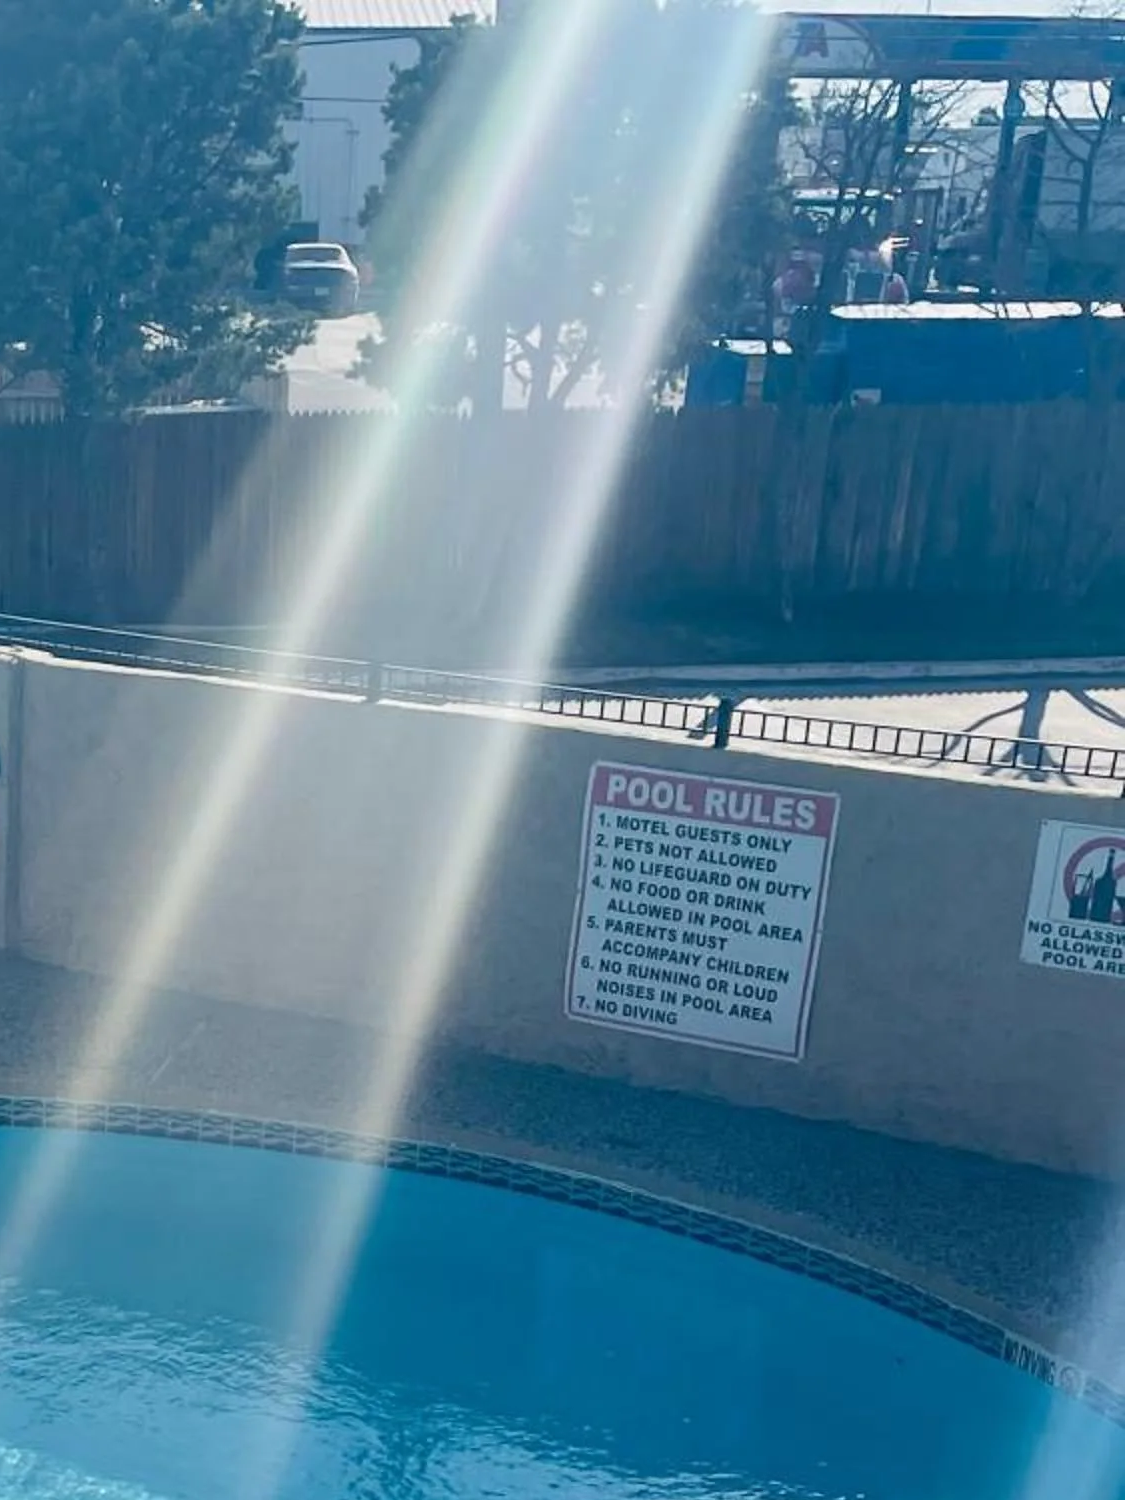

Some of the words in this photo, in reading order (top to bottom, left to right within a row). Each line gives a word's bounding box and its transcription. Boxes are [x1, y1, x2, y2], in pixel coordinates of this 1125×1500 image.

[606, 774, 694, 814] POOL
[703, 787, 818, 830] RULES
[594, 833, 608, 849] 2.
[614, 836, 654, 855] PETS
[658, 844, 693, 860] NOT
[696, 849, 778, 873] ALLOWED
[598, 813, 611, 829] 1.
[615, 815, 670, 837] MOTEL
[675, 824, 742, 846] GUESTS
[746, 835, 793, 854] ONLY
[591, 875, 605, 889] 4.
[610, 877, 633, 893] NO
[637, 881, 681, 901] FOOD
[686, 889, 710, 905] OR
[714, 894, 767, 916] DRINK
[593, 853, 607, 868] 3.
[611, 856, 635, 872] NO
[639, 859, 732, 886] LIFEGUARD
[736, 876, 760, 892] ON
[765, 881, 812, 902] DUTY
[586, 915, 599, 930] 5.
[604, 919, 678, 943] PARENTS
[681, 931, 728, 951] MUST
[606, 899, 682, 922] ALLOWED
[687, 910, 706, 927] IN
[710, 913, 753, 935] POOL
[757, 925, 803, 943] AREA
[1027, 919, 1052, 935] NO
[601, 939, 702, 967] ACCOMPANY
[706, 957, 790, 984] CHILDREN
[1040, 936, 1123, 959] ALLOWED
[1041, 951, 1088, 969] POOL
[580, 955, 594, 970] 6.
[599, 958, 623, 974] NO
[627, 963, 701, 990] RUNNING
[706, 977, 730, 994] OR
[734, 982, 779, 1004] LOUD
[576, 995, 590, 1011] 7.
[594, 999, 618, 1015] NO
[622, 1003, 679, 1026] DIVING
[596, 978, 655, 1002] NOISES
[660, 990, 678, 1005] IN
[682, 994, 724, 1015] POOL
[728, 1004, 773, 1023] AREA
